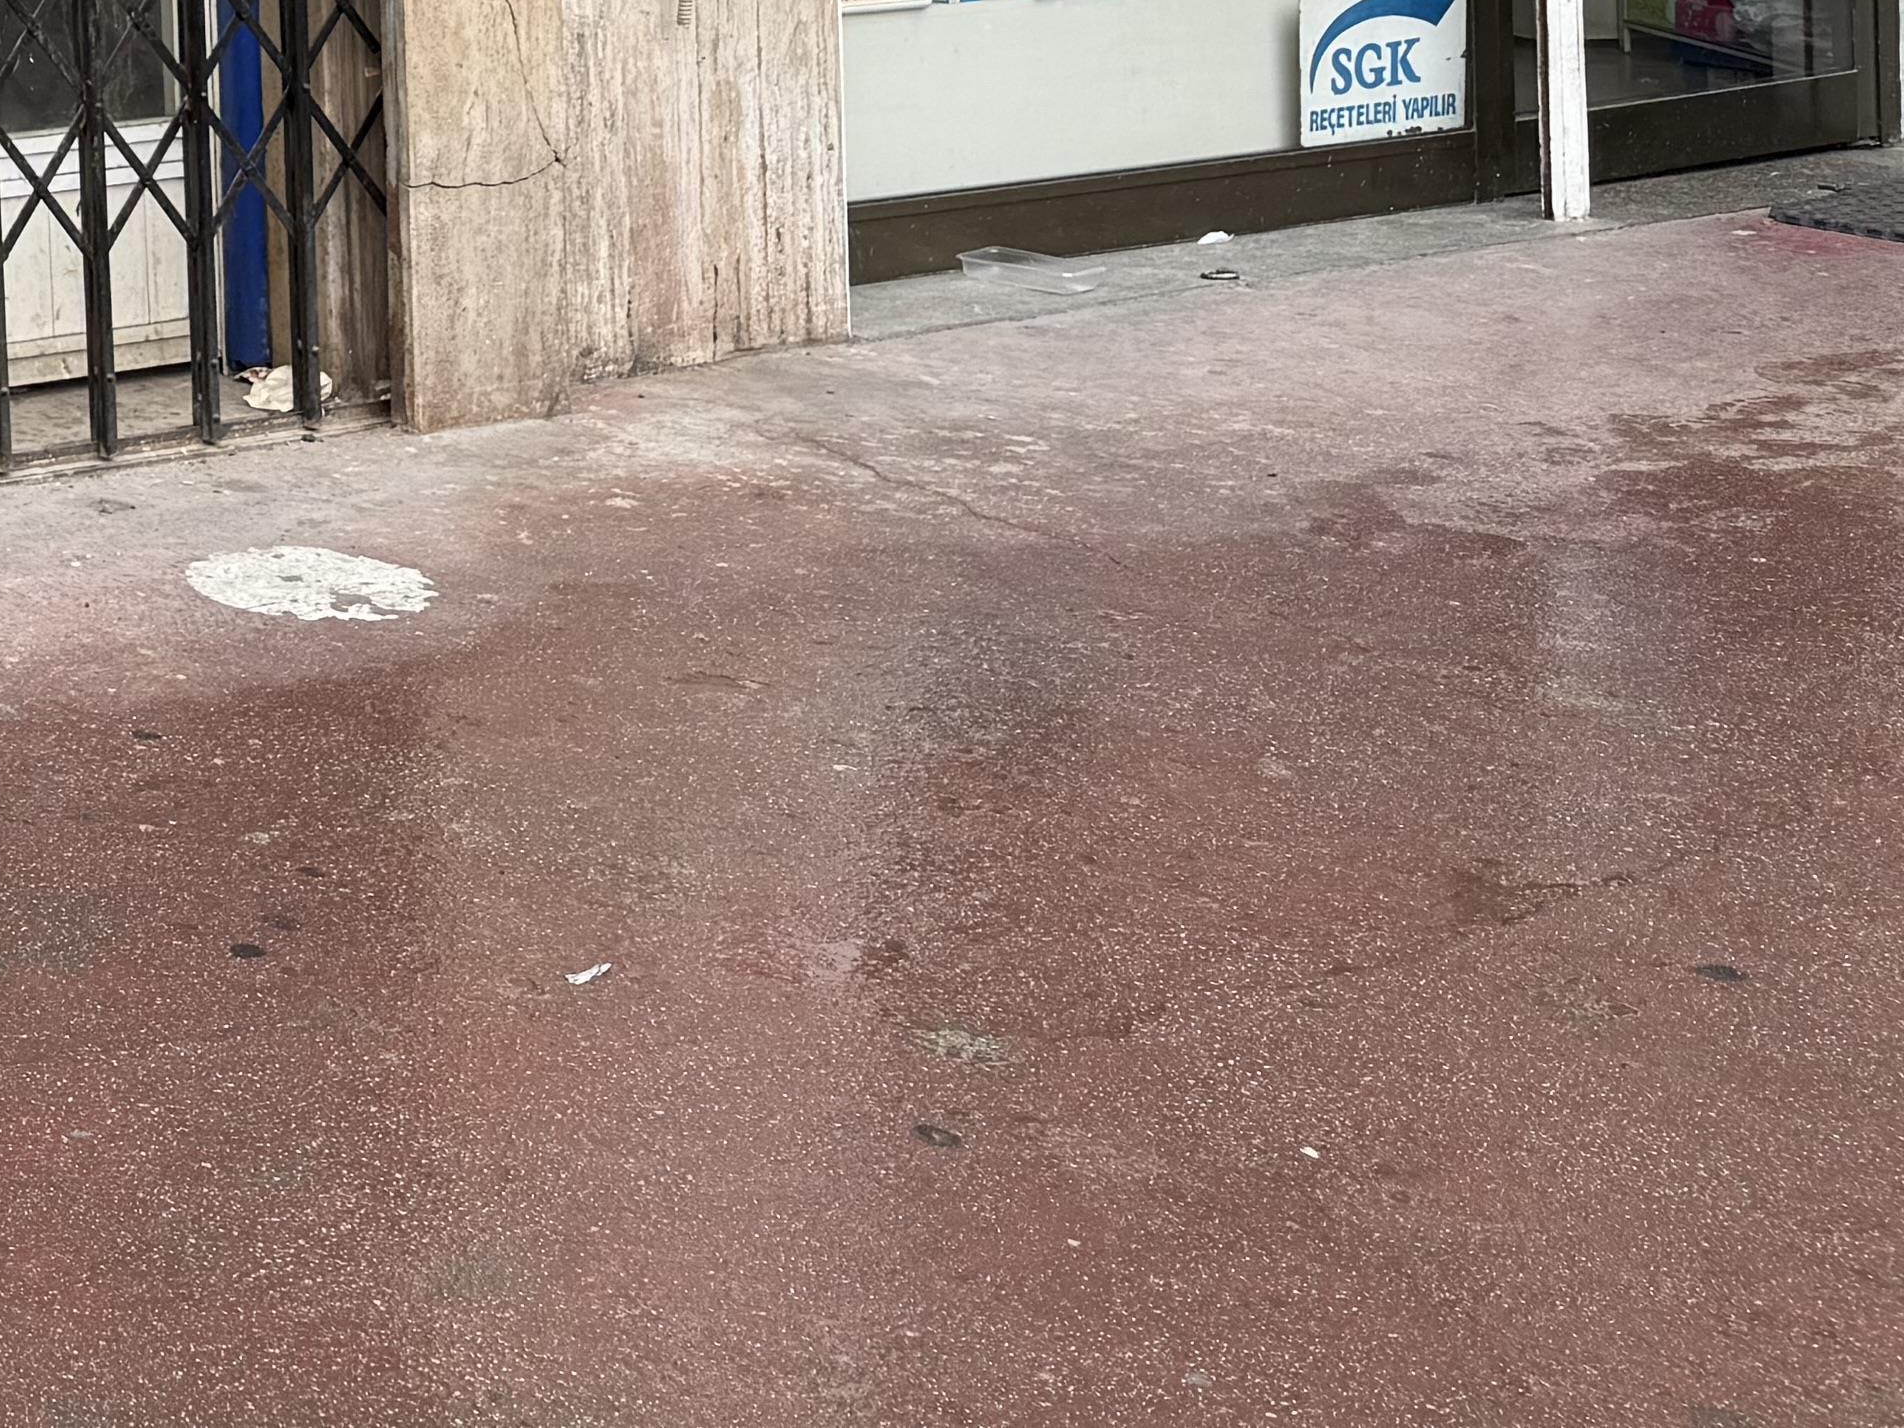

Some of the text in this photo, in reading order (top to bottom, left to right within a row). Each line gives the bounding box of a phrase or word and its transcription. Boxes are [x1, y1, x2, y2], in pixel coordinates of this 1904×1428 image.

[1329, 36, 1421, 96] SGK
[1309, 91, 1457, 137] REÇETELERİ YAPILIR
